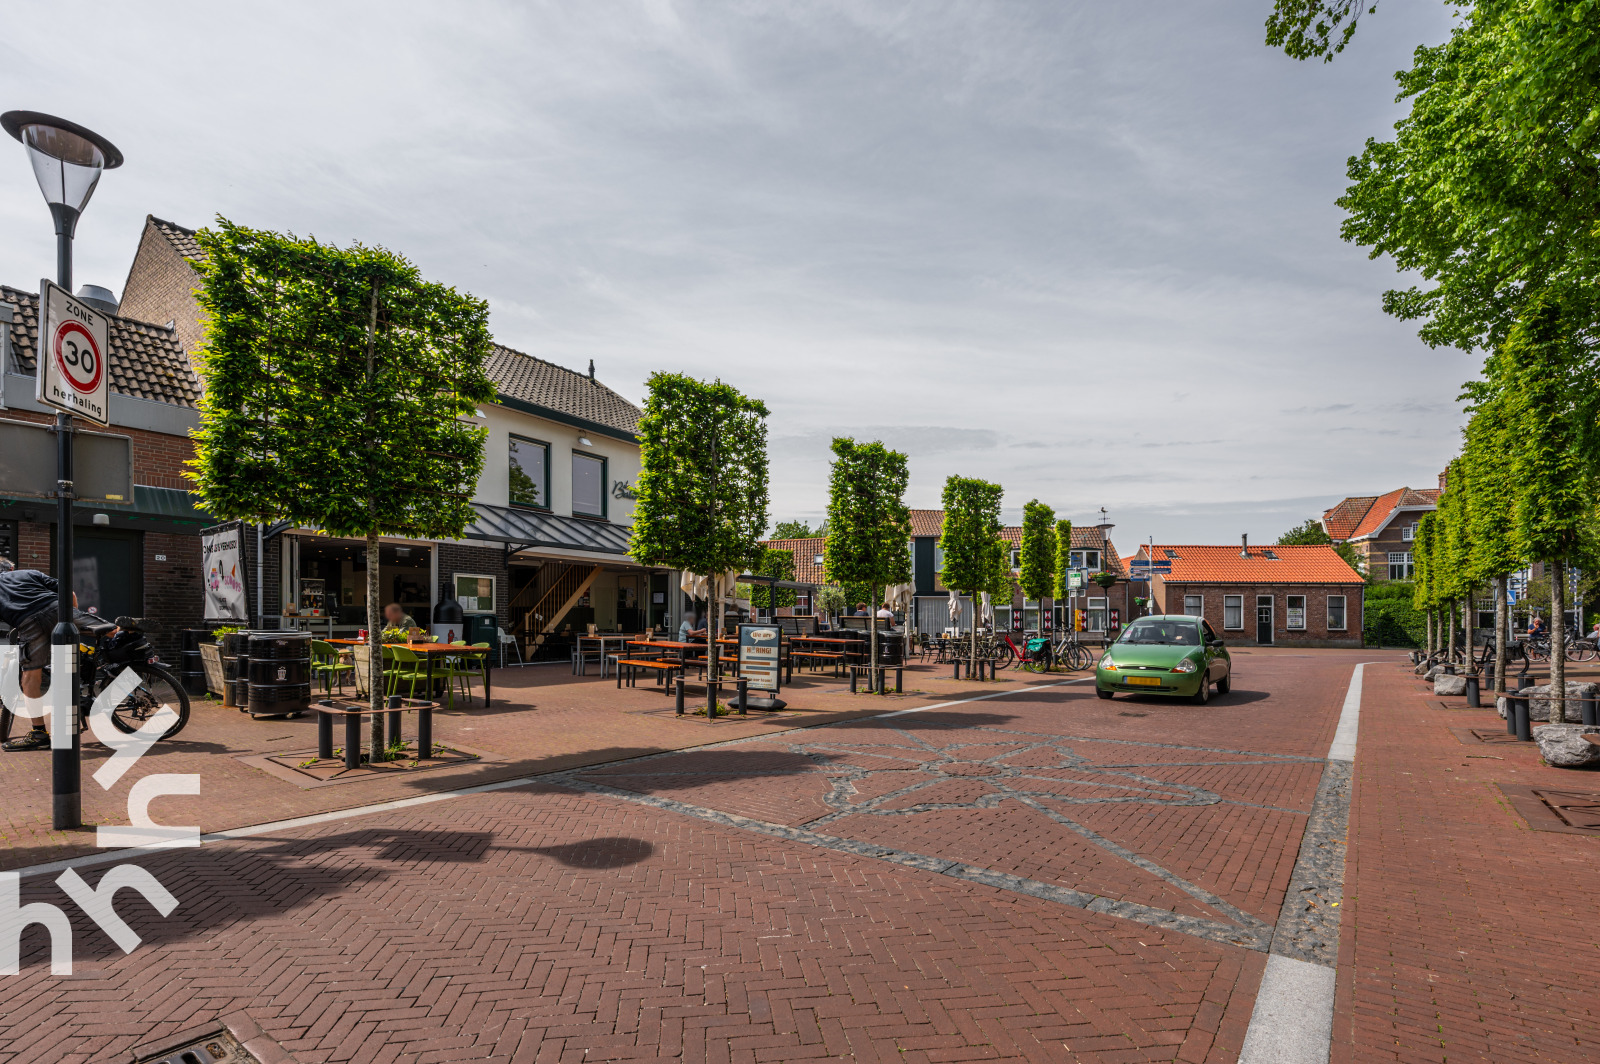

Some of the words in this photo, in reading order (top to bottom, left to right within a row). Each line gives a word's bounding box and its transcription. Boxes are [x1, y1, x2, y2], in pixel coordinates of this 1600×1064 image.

[66, 300, 94, 326] ZONE
[64, 340, 94, 374] 30
[53, 385, 102, 417] herhaling
